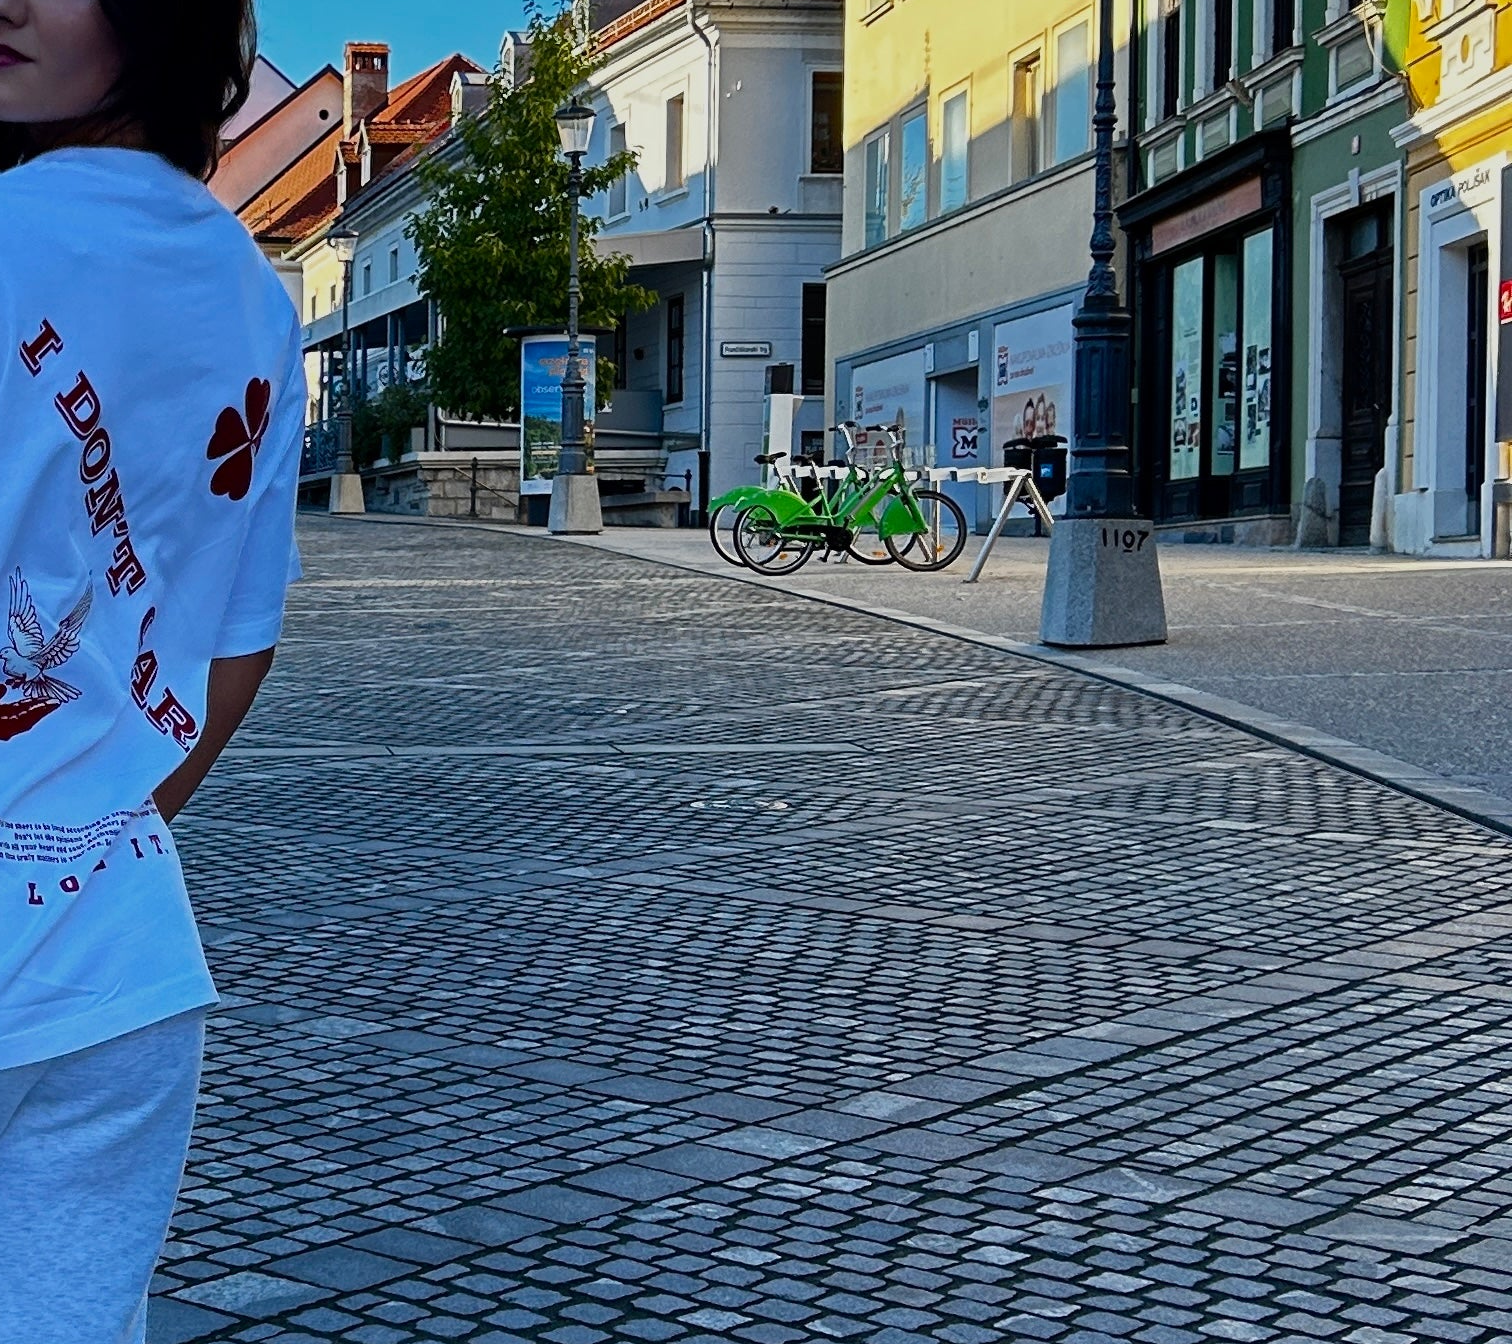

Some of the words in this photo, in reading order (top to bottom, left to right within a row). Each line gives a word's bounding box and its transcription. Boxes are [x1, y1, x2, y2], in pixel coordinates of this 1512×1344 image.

[1430, 185, 1456, 208] OPTIKA
[20, 317, 64, 377] I
[54, 369, 147, 598] DON'T
[1102, 528, 1149, 552] 1107
